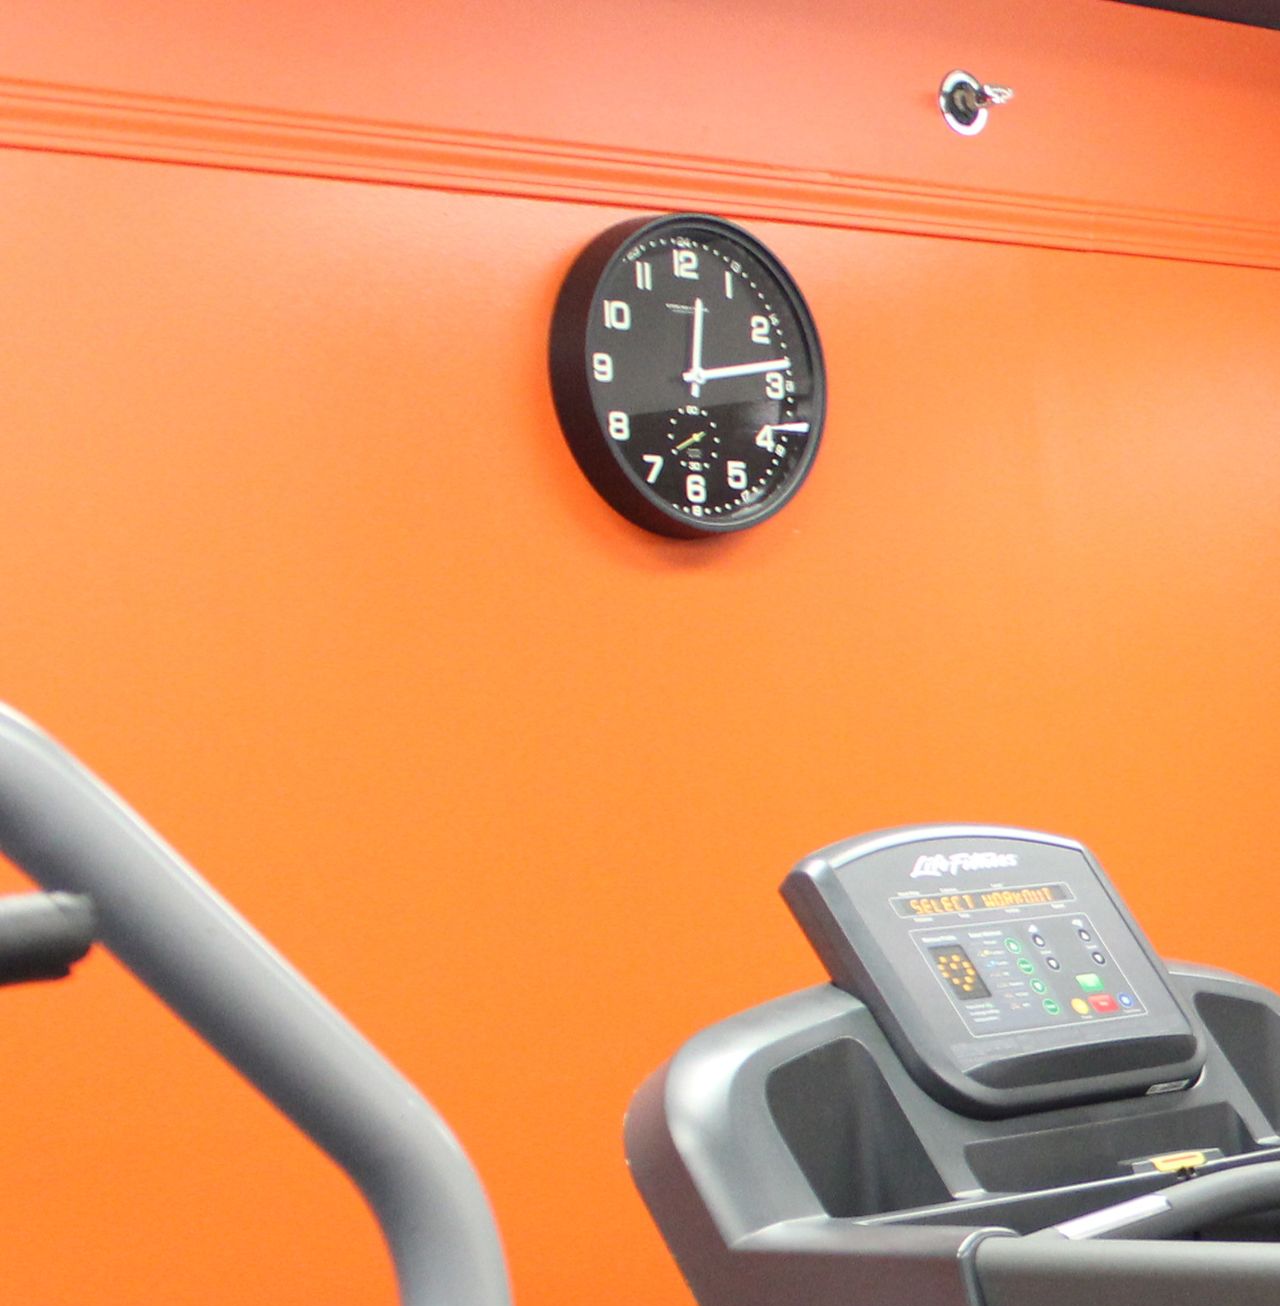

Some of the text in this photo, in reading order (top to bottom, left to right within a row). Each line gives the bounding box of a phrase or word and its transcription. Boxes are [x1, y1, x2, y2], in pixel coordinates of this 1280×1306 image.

[635, 261, 652, 291] 11
[672, 249, 699, 280] 12
[724, 270, 733, 299] 1
[603, 299, 631, 330] 10
[751, 315, 771, 345] 2
[592, 352, 614, 382] 9
[765, 371, 785, 400] 3
[608, 411, 630, 440] 8
[755, 424, 775, 453] 4
[642, 454, 663, 483] 7
[727, 460, 747, 489] 5
[686, 474, 707, 503] 6
[909, 887, 1053, 915] SELECT WORKOUT
